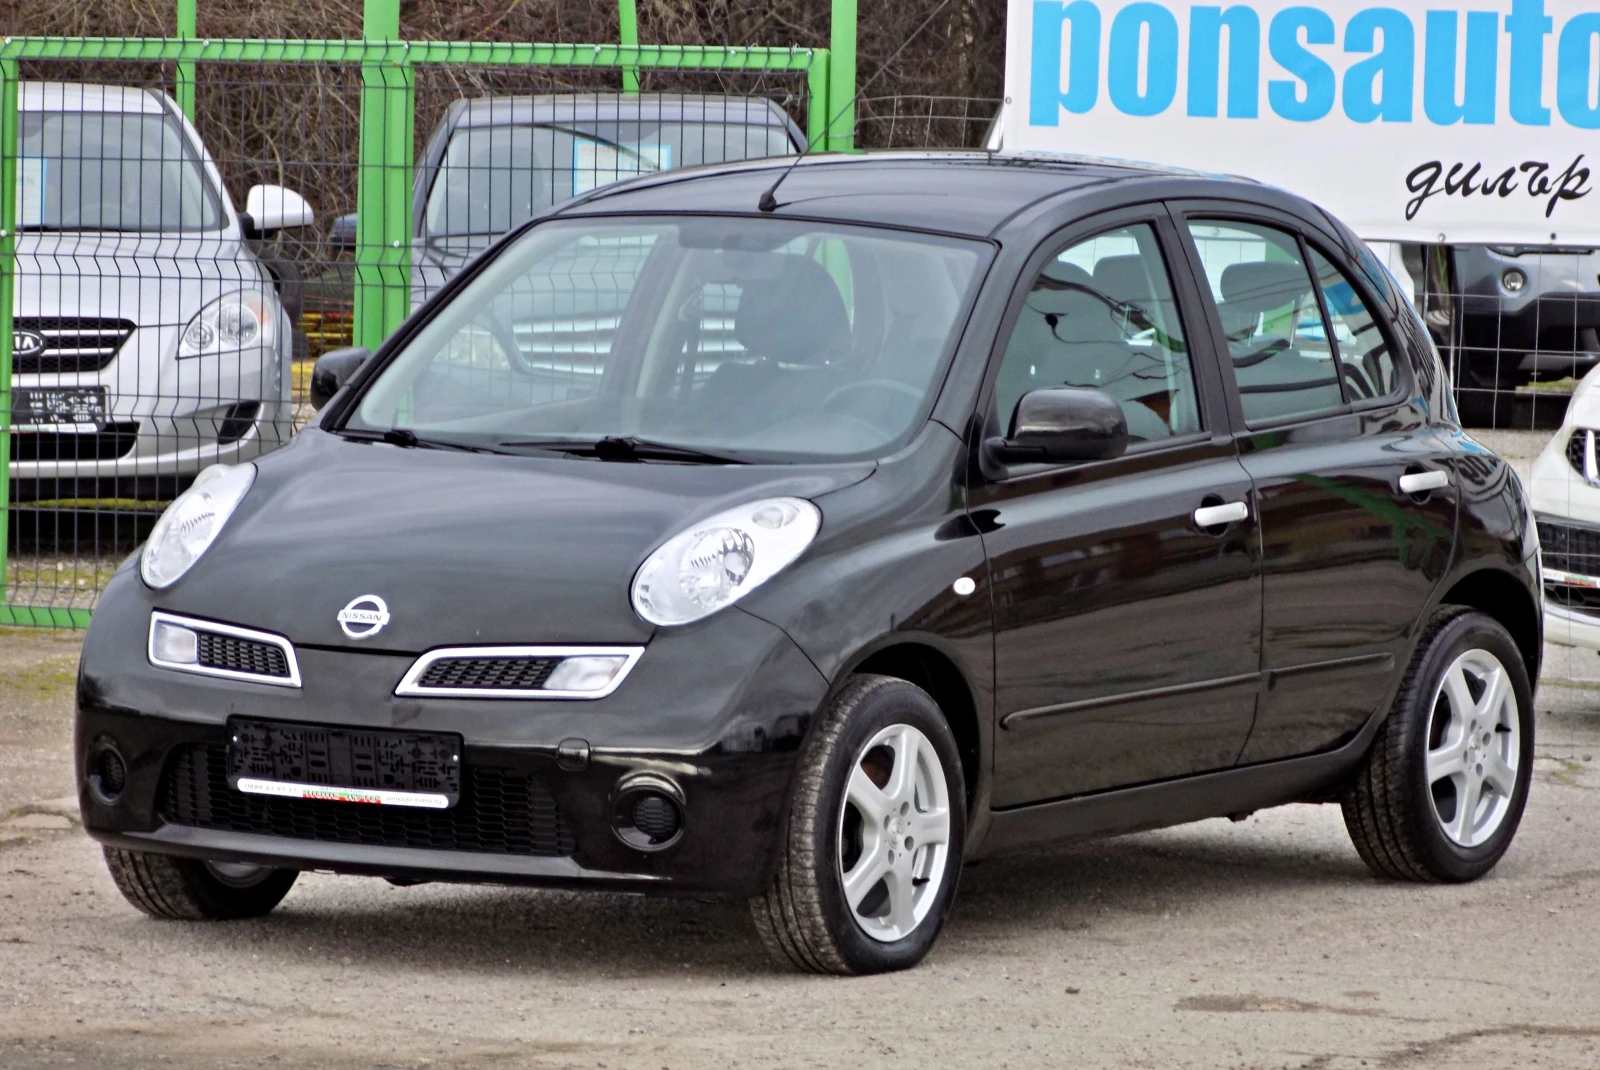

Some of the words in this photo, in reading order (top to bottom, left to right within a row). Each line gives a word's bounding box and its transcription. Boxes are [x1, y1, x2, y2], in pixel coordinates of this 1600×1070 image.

[1029, 0, 1600, 129] ponsauto
[1405, 154, 1593, 221] дилър
[342, 612, 382, 621] NISSAN
